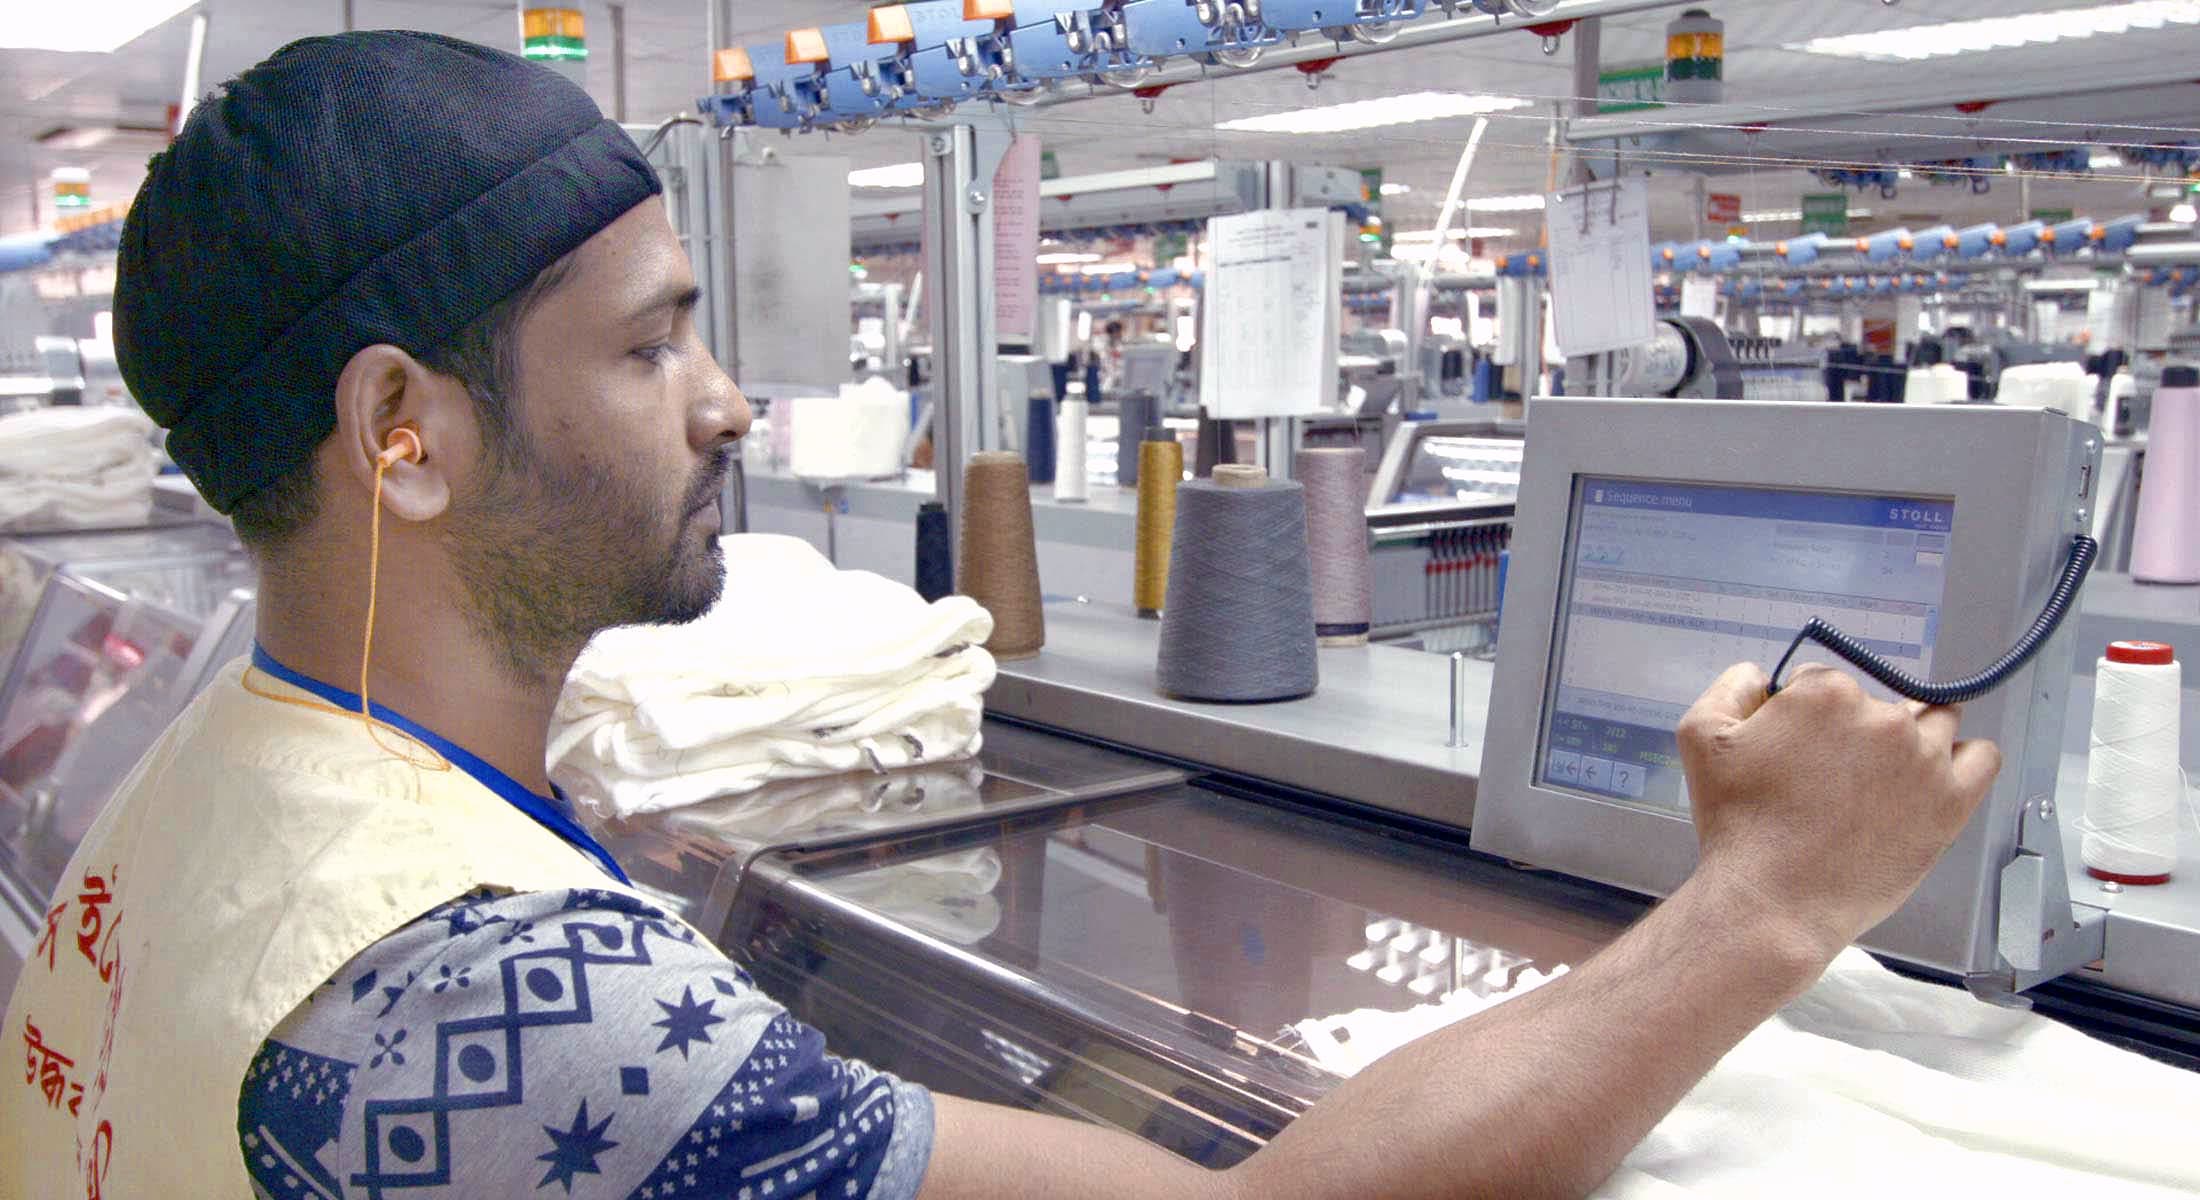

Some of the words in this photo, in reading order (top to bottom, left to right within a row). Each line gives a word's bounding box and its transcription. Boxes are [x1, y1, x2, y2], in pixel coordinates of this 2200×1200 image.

[1607, 488, 1659, 505] Sequence
[1662, 495, 1693, 507] menu
[1889, 508, 1944, 523] STOLL
